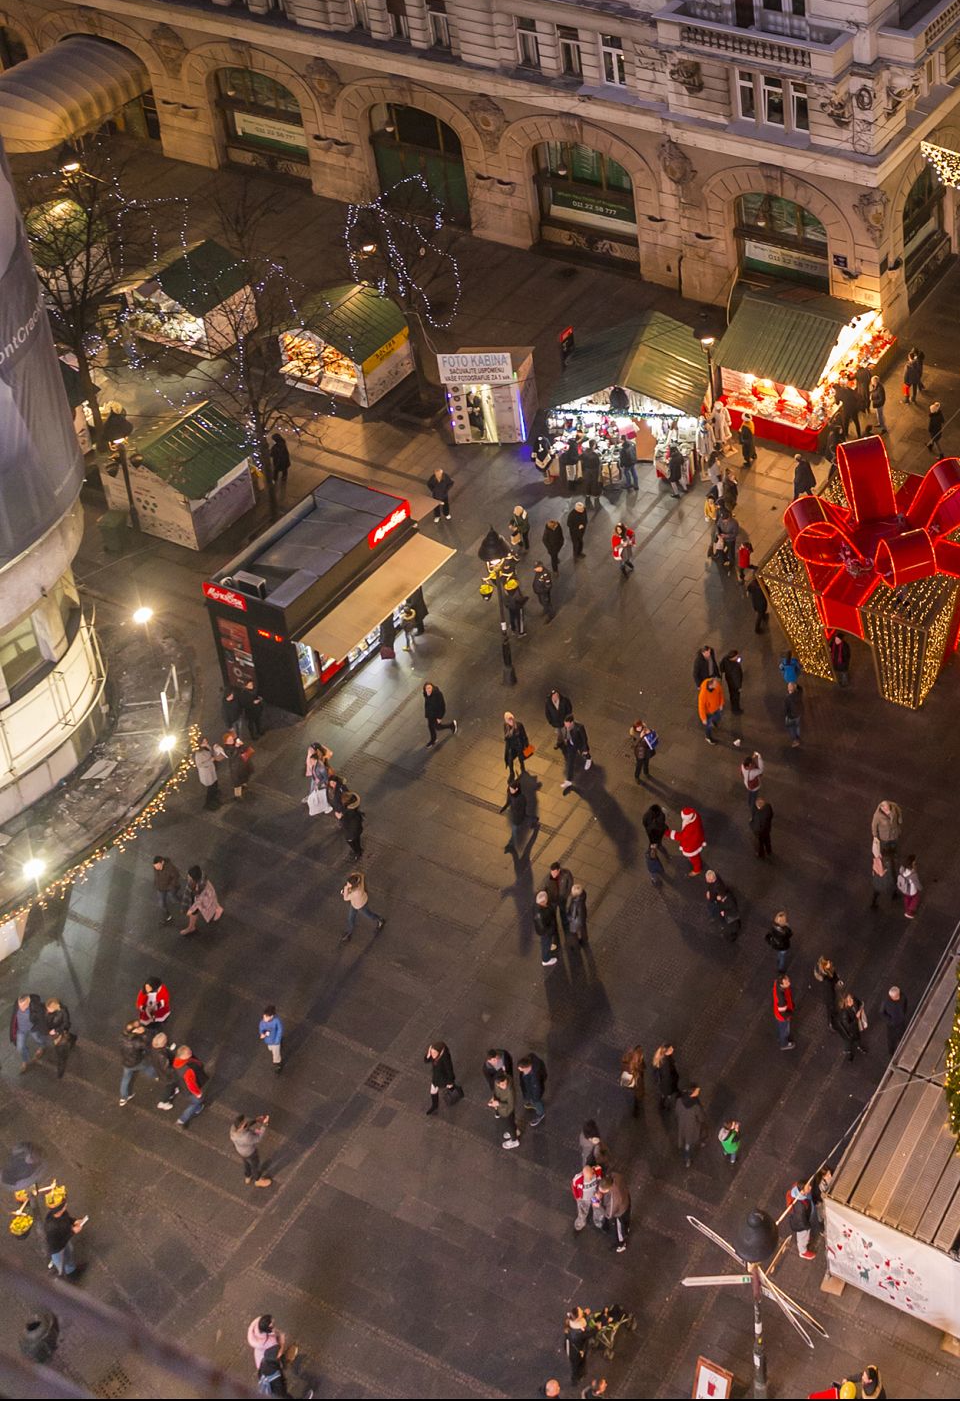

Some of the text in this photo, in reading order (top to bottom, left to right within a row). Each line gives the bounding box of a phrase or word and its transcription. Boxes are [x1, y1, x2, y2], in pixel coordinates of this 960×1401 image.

[584, 202, 593, 210] 22
[441, 355, 508, 367] FOTO KABINA
